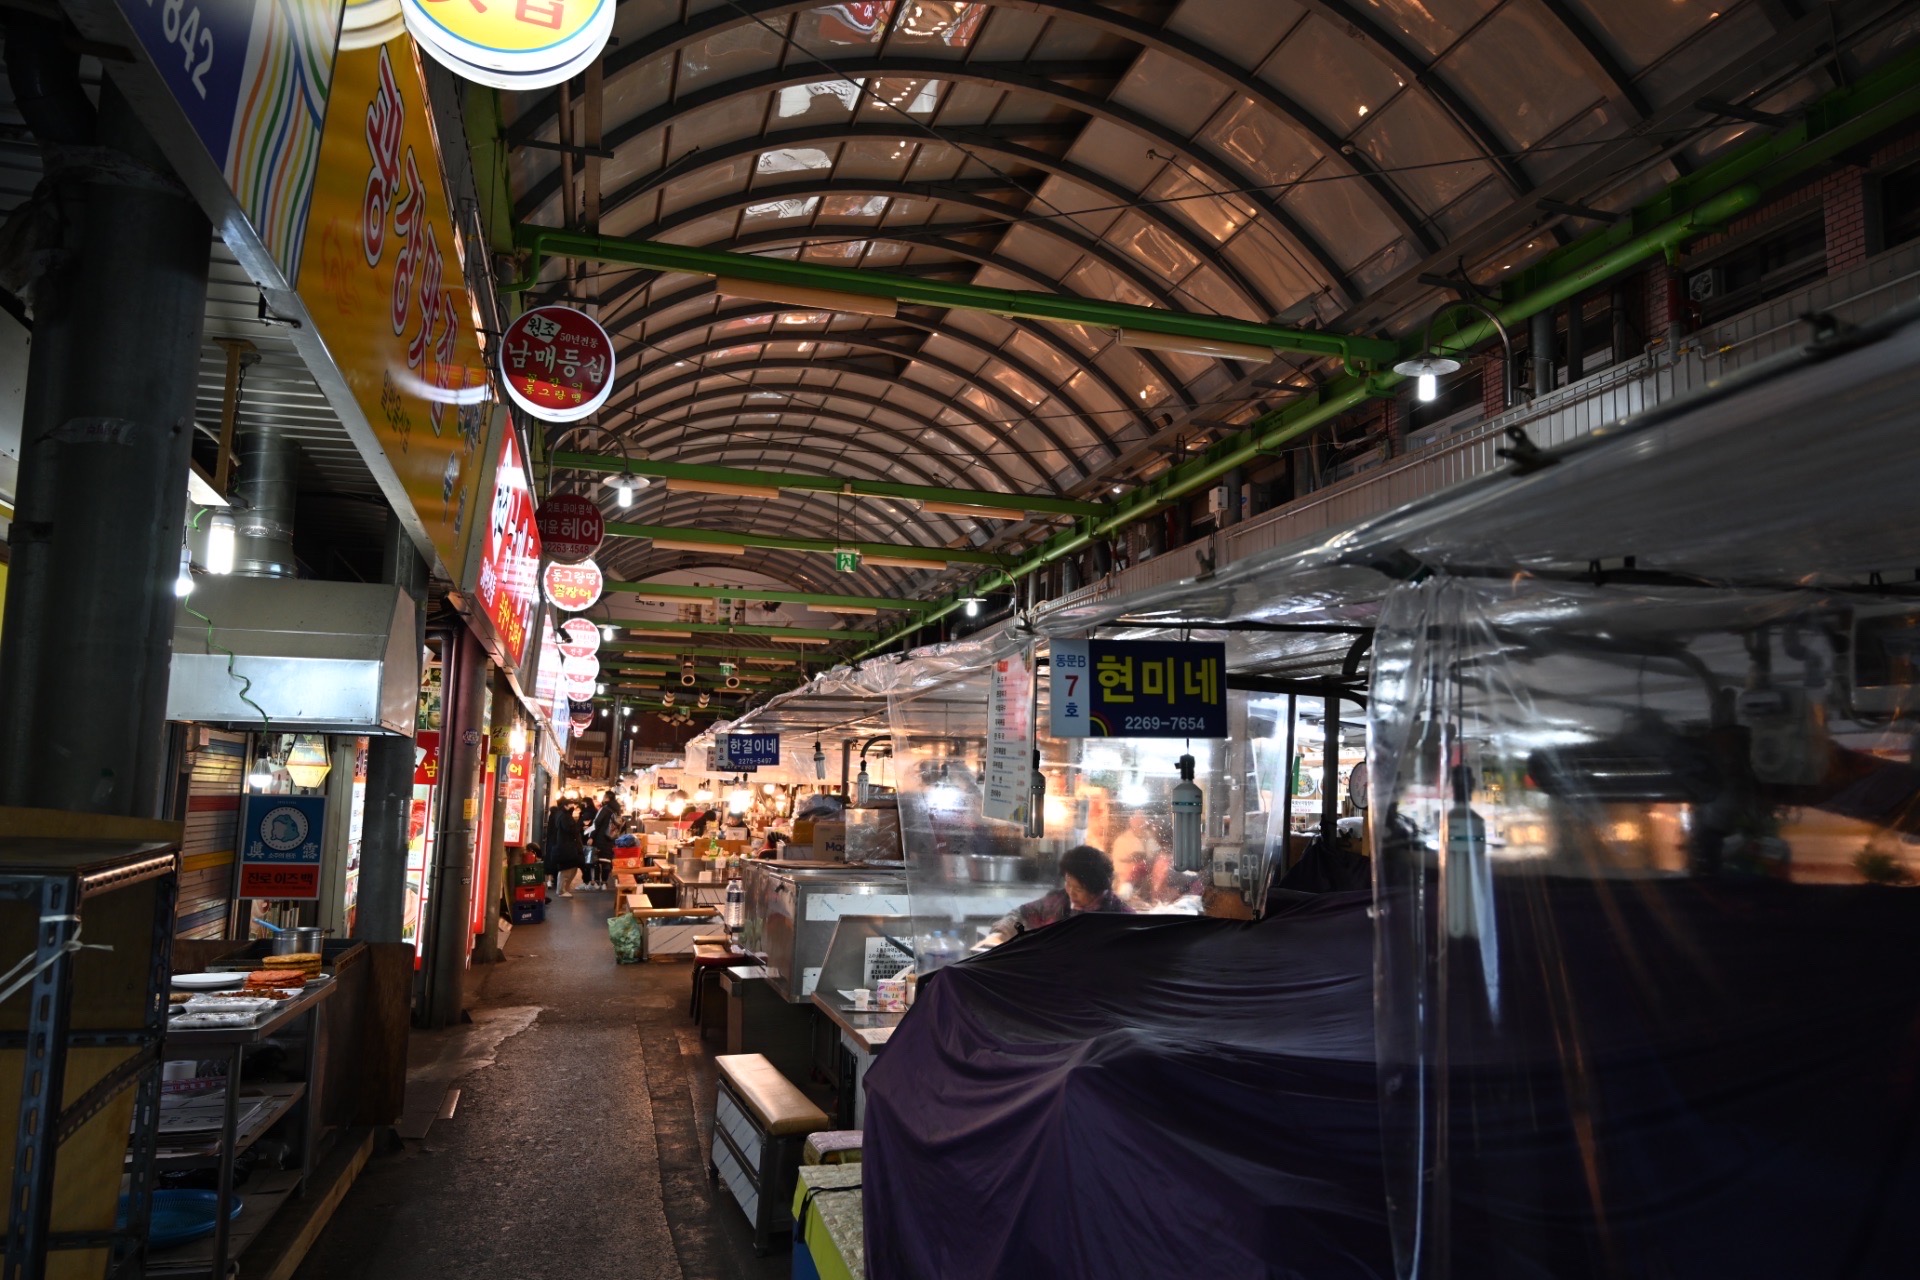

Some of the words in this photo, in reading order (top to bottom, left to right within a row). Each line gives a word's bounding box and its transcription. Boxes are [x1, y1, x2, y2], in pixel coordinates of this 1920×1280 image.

[145, 0, 214, 99] 842
[363, 43, 458, 437] 광장맛집
[527, 316, 555, 337] 원조
[559, 332, 599, 348] 50년전통
[507, 339, 606, 383] 남매등심
[547, 543, 590, 554] 2263-4548
[552, 583, 592, 600] 꼼장어
[1055, 652, 1087, 669] 동문B
[1065, 674, 1079, 698] 7
[1096, 655, 1218, 706] 현미네
[1063, 702, 1080, 718] 호
[1124, 716, 1205, 732] 2269-7654
[730, 738, 777, 754] 한결이네
[738, 757, 772, 765] 2275-5497
[247, 872, 272, 884] 진로
[274, 873, 298, 885] 이즈
[301, 873, 314, 885] 백
